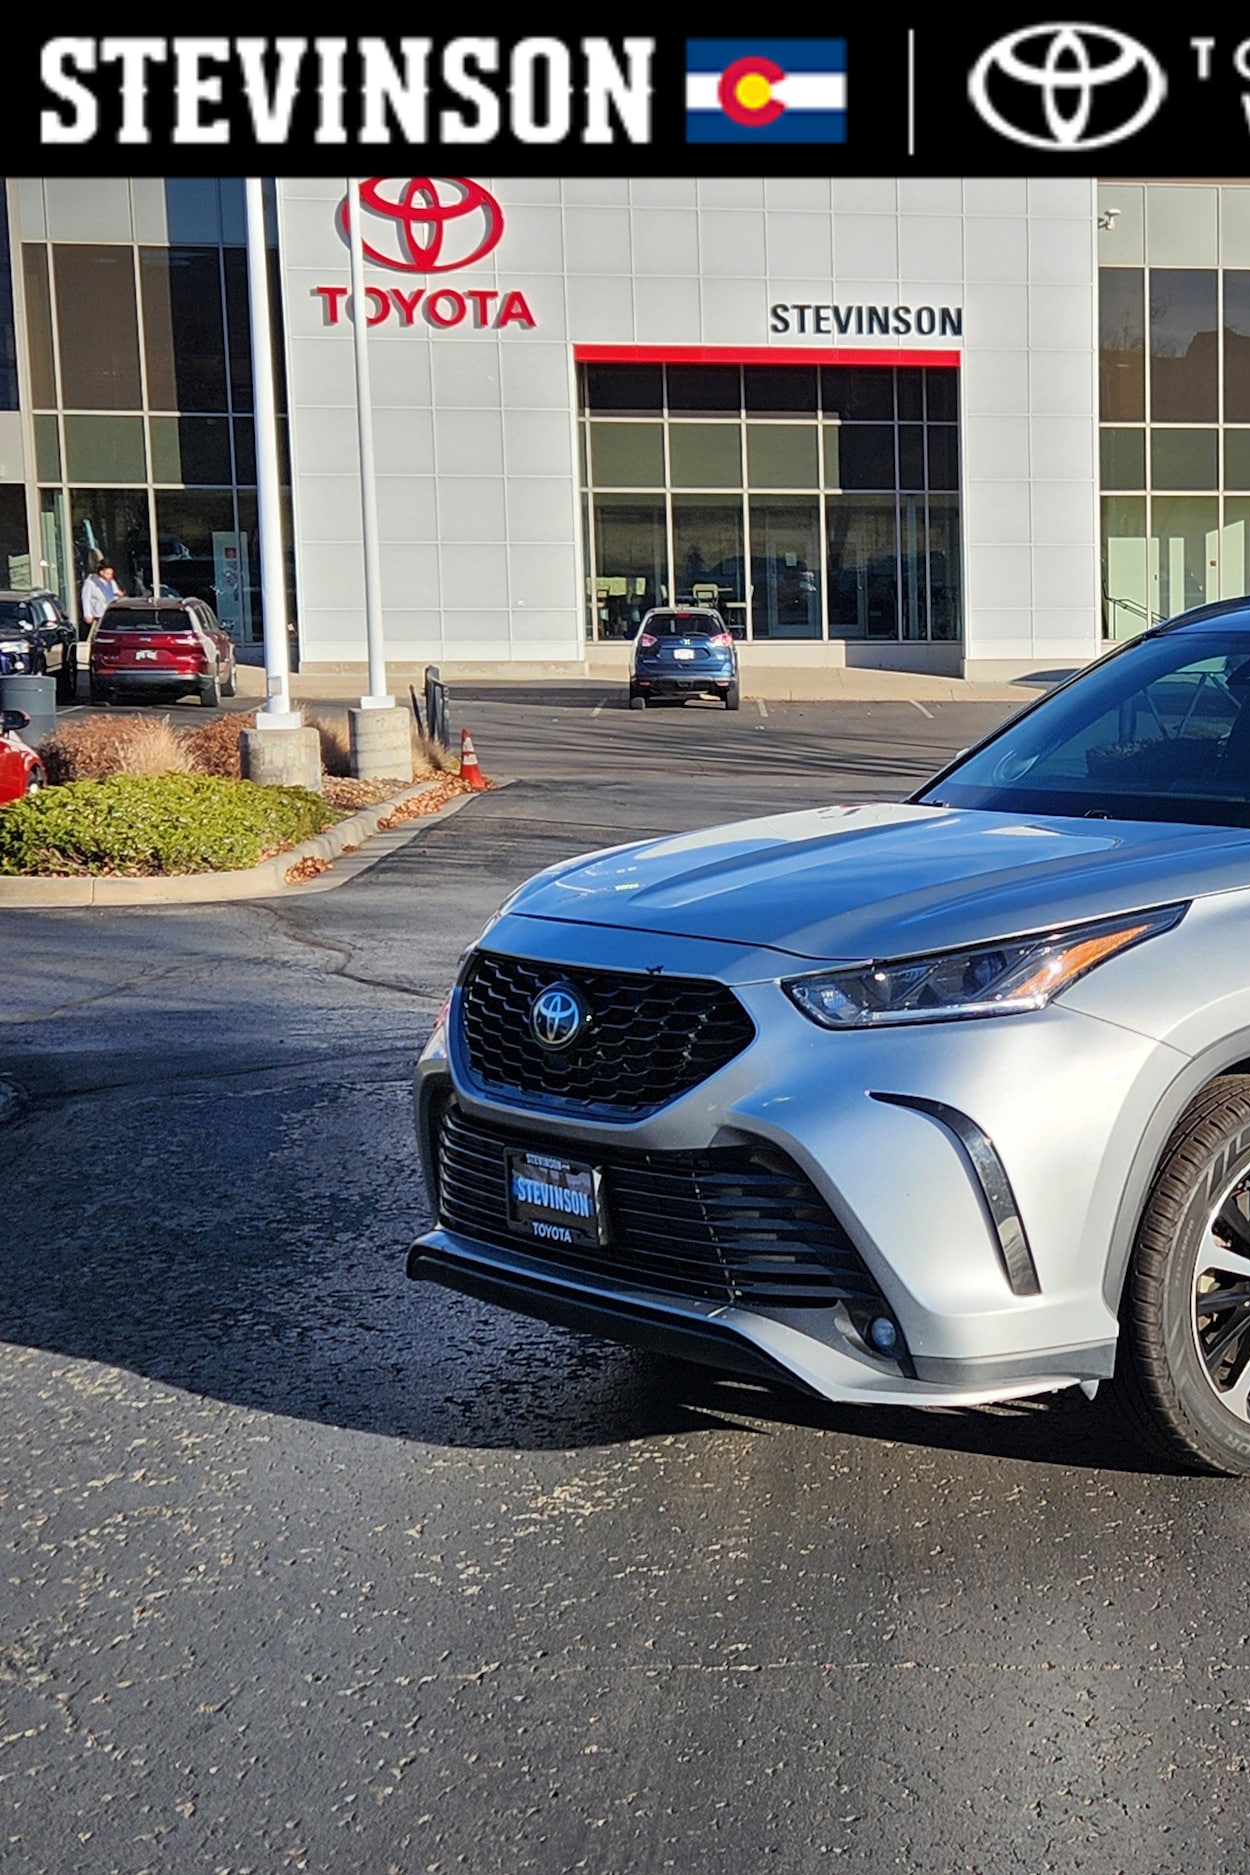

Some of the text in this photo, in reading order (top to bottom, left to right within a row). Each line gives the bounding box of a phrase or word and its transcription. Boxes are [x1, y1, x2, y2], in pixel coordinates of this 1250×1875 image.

[314, 286, 537, 328] TOYOTA
[770, 304, 963, 336] STEVINSON
[517, 1177, 589, 1218] STEVINSON
[532, 1222, 572, 1243] TOYOTA
